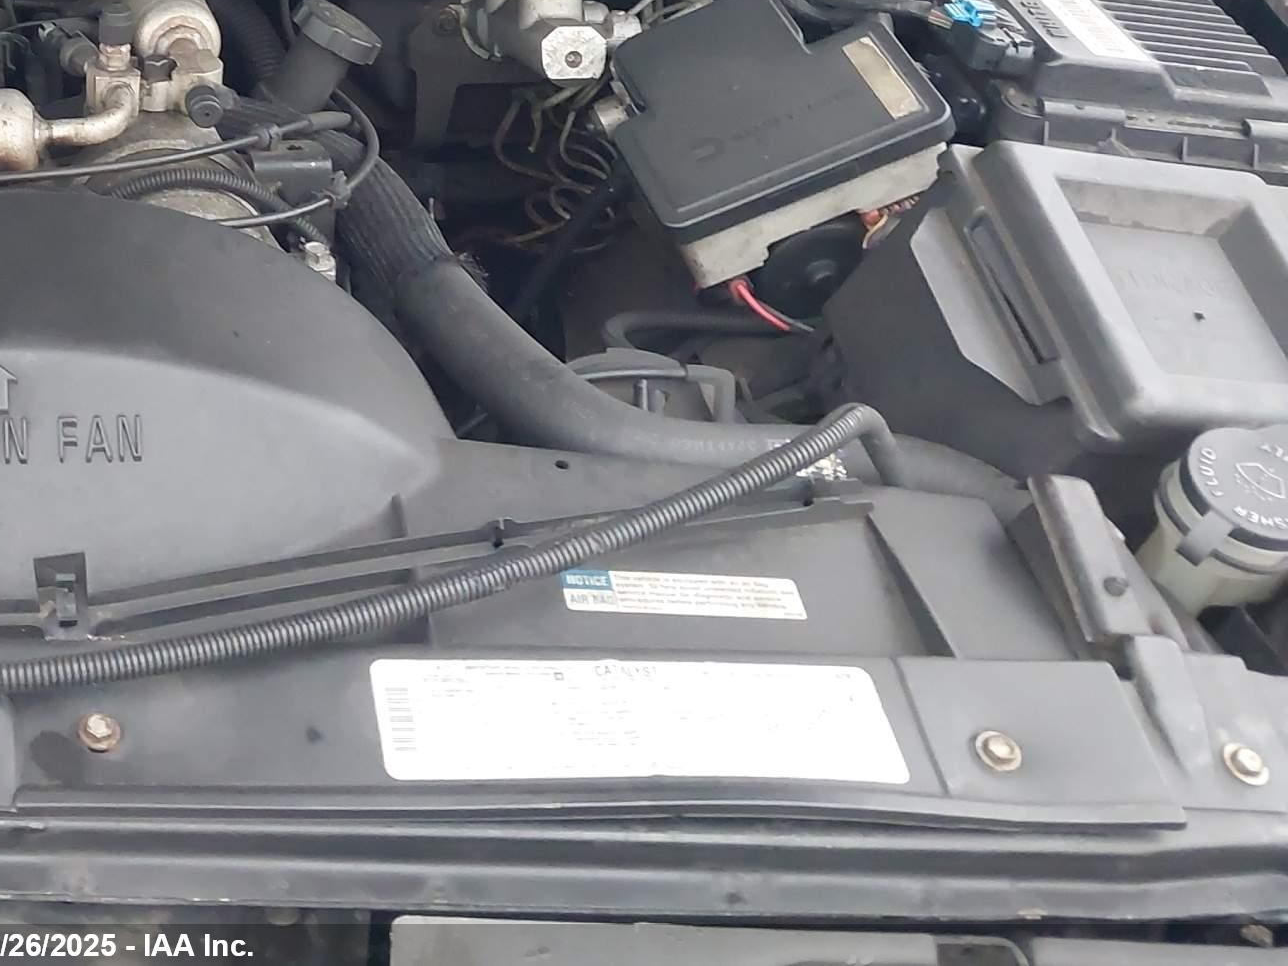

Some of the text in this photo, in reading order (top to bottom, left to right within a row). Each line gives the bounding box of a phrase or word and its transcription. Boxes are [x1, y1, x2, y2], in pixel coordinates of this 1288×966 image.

[57, 414, 145, 463] FAN
[1233, 505, 1288, 531] SHER
[565, 574, 610, 588] NOTICE
[593, 664, 657, 678] CAALYS
